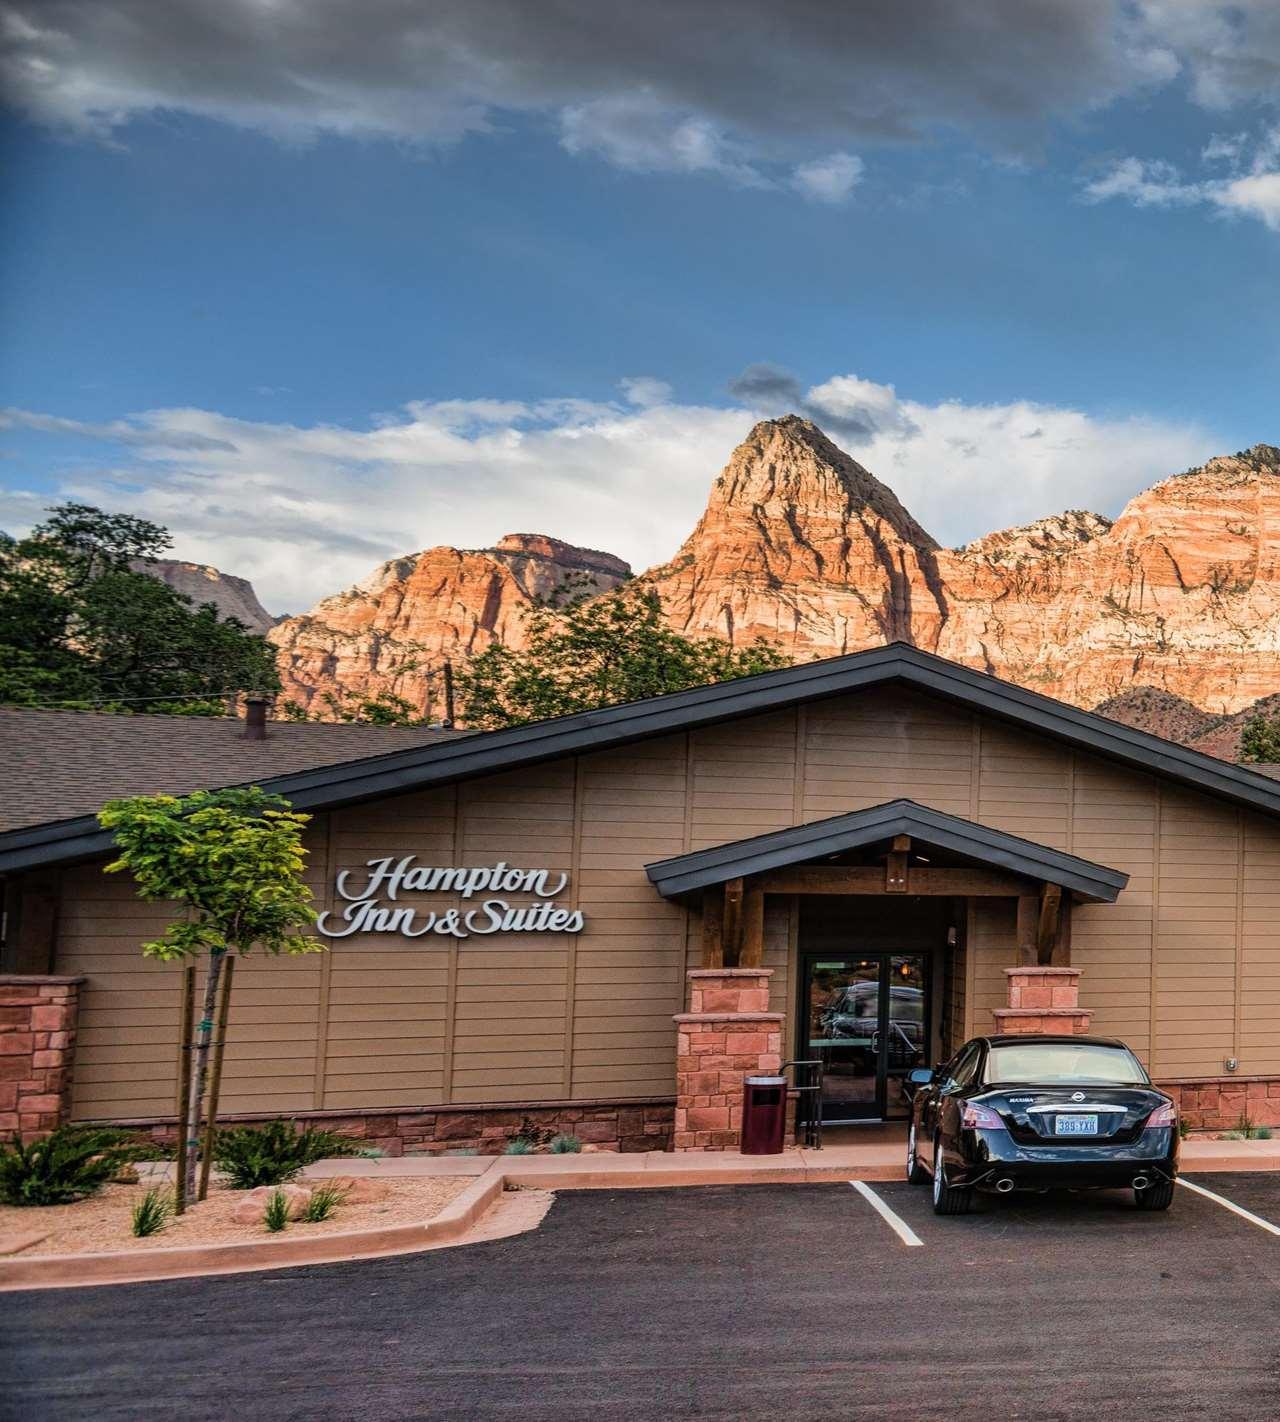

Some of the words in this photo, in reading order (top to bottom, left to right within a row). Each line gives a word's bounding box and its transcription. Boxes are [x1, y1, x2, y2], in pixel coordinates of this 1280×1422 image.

[337, 855, 567, 900] Hampton
[317, 900, 436, 937] Inn
[434, 908, 469, 937] &
[465, 900, 584, 934] Suites
